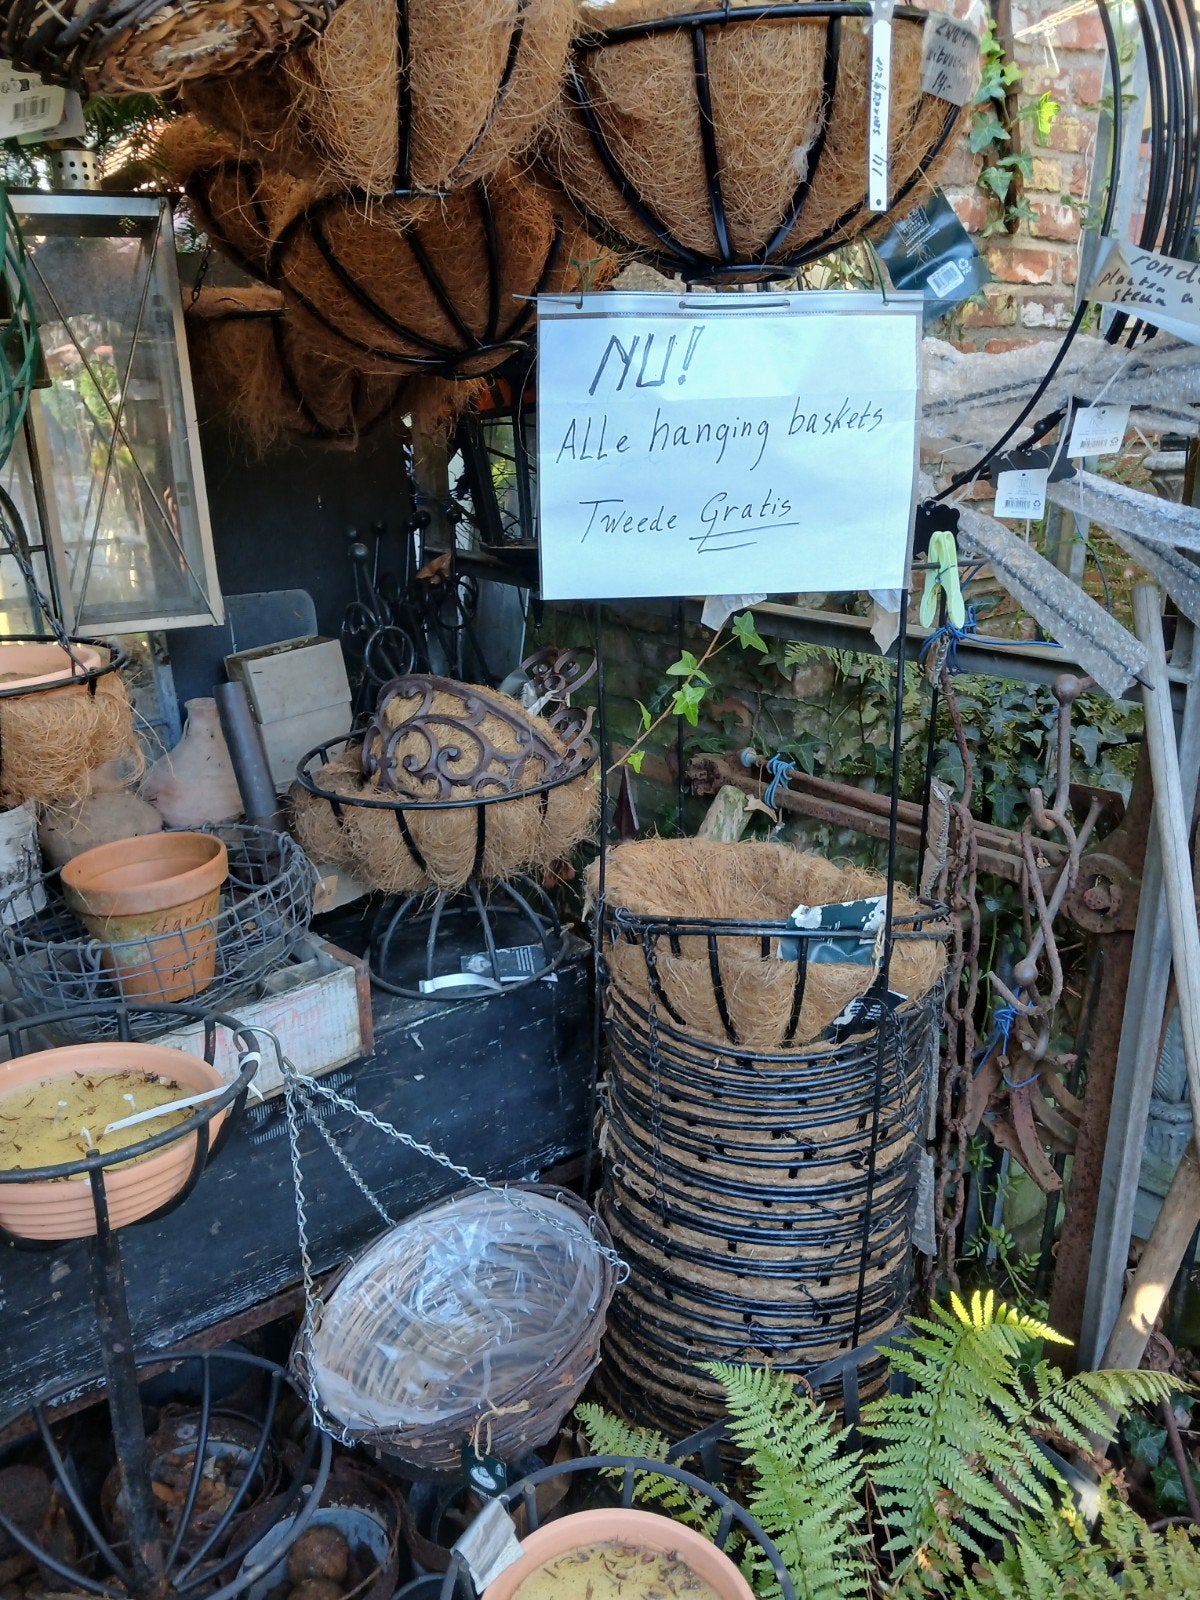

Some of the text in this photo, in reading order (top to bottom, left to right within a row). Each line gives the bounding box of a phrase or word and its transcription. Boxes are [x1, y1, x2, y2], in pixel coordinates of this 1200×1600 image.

[1130, 255, 1200, 284] rond
[588, 325, 706, 396] NU!
[648, 407, 770, 472] hanging
[788, 396, 884, 436] baskets
[578, 488, 794, 552] Tweede Gratis
